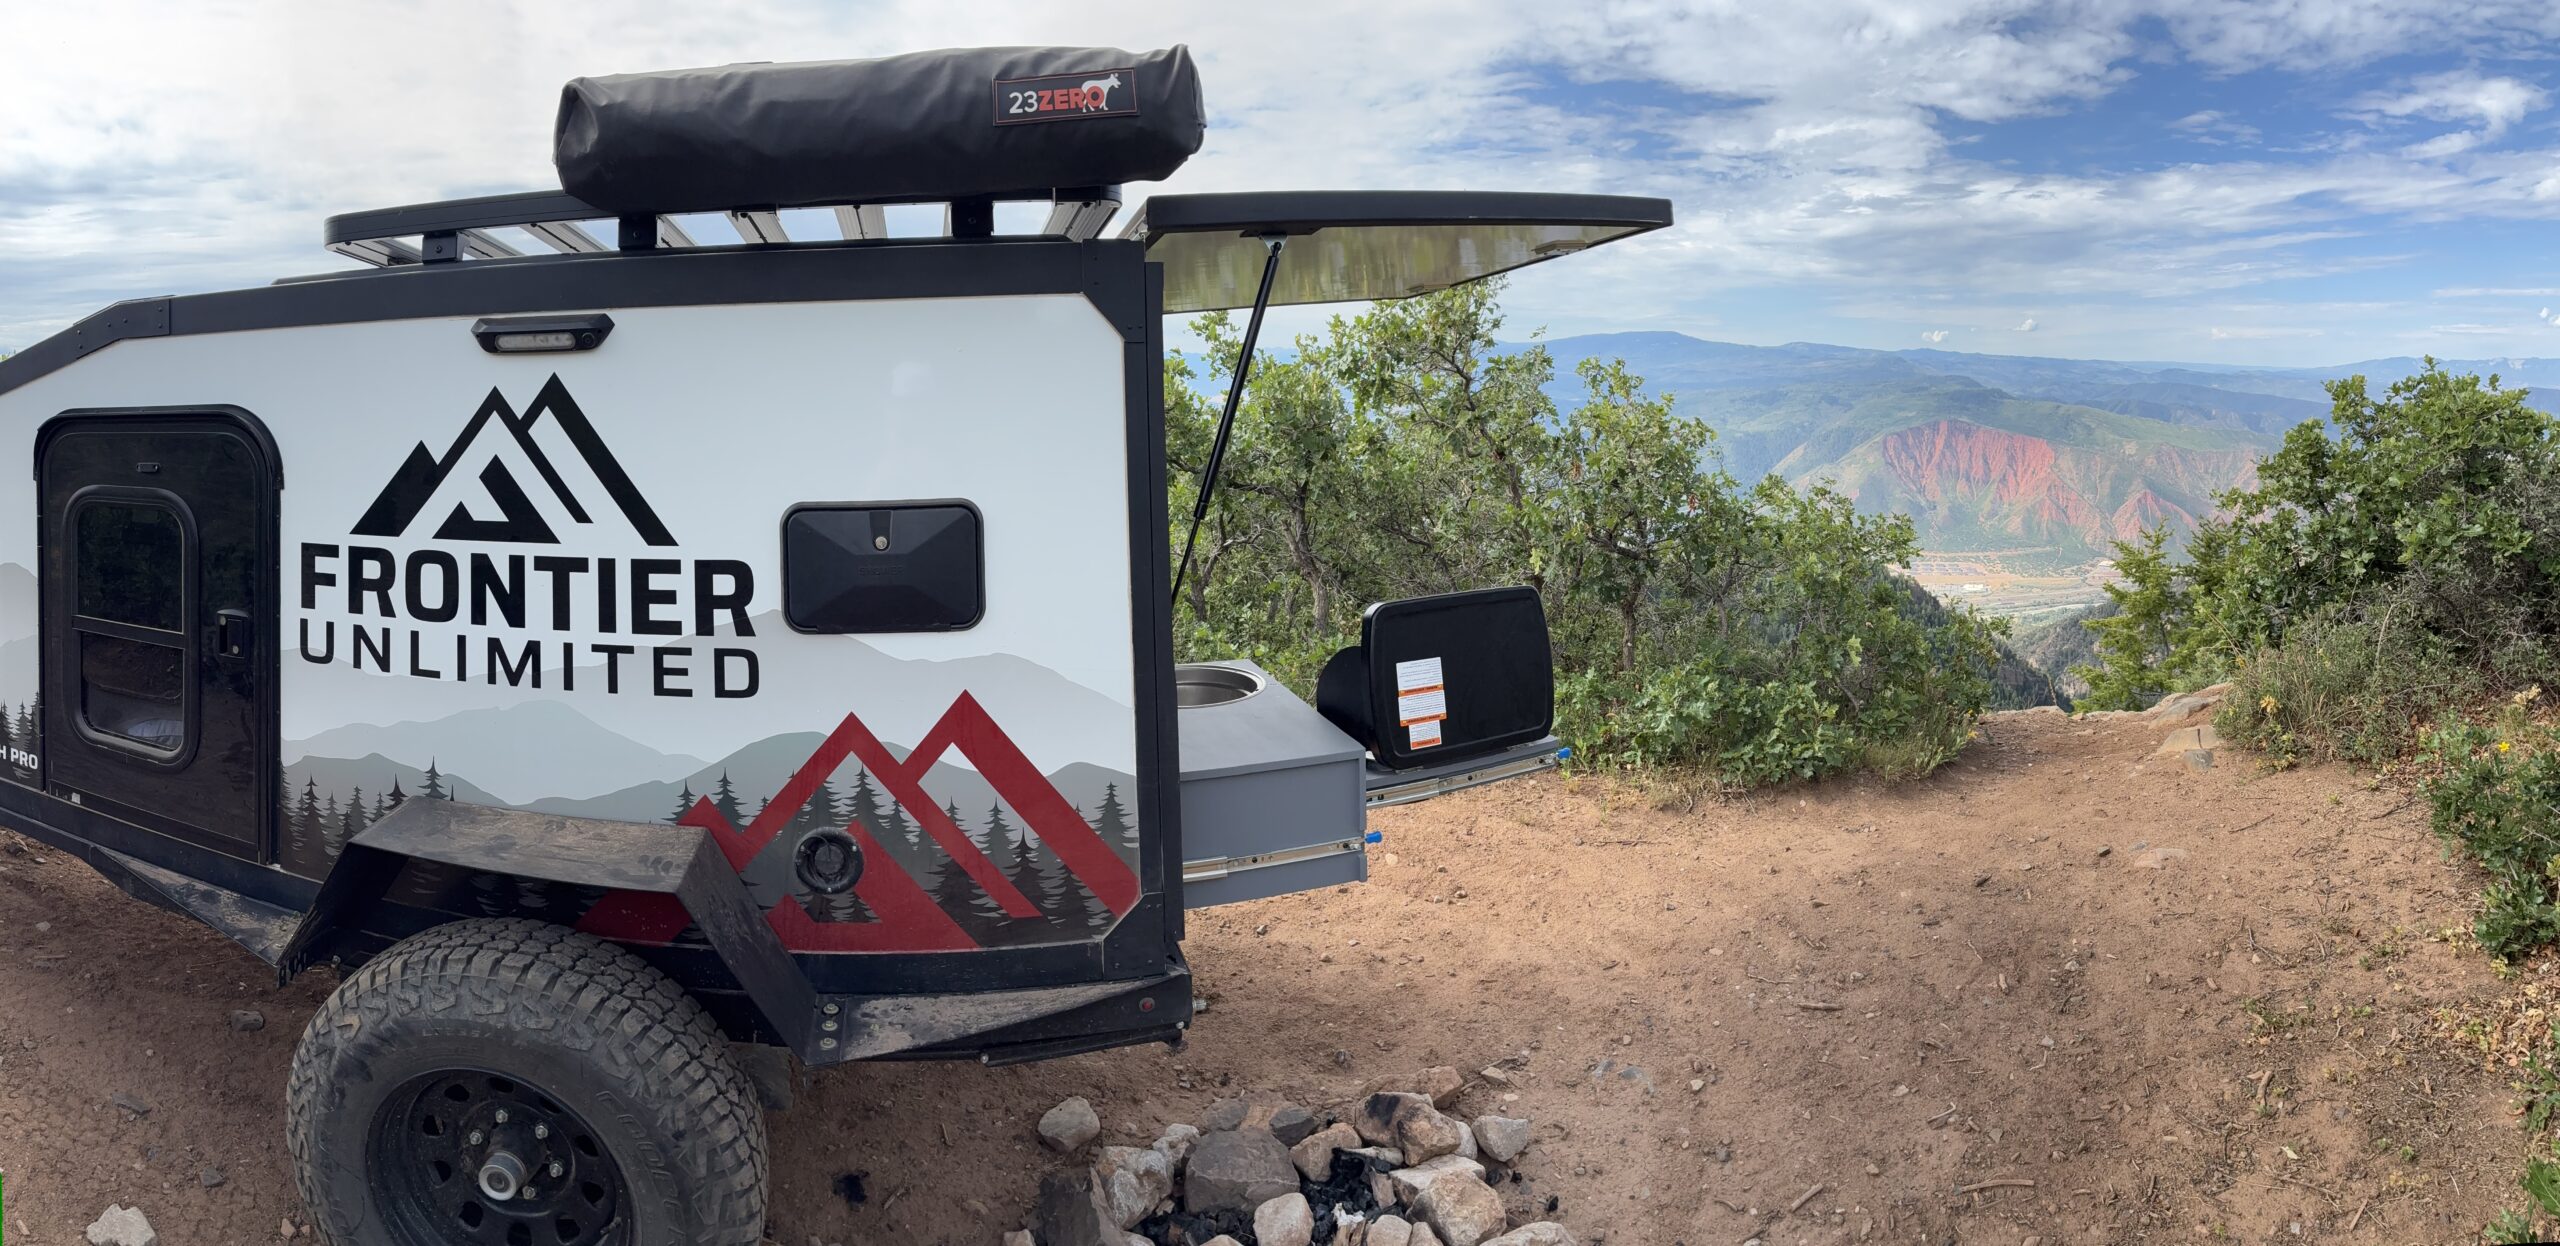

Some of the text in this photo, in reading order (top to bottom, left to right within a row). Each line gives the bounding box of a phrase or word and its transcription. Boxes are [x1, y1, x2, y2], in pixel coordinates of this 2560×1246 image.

[1009, 85, 1106, 114] 23ZERO
[301, 541, 756, 637] FRONTIER
[300, 617, 760, 699] UNLIMITED
[10, 747, 38, 770] PRO
